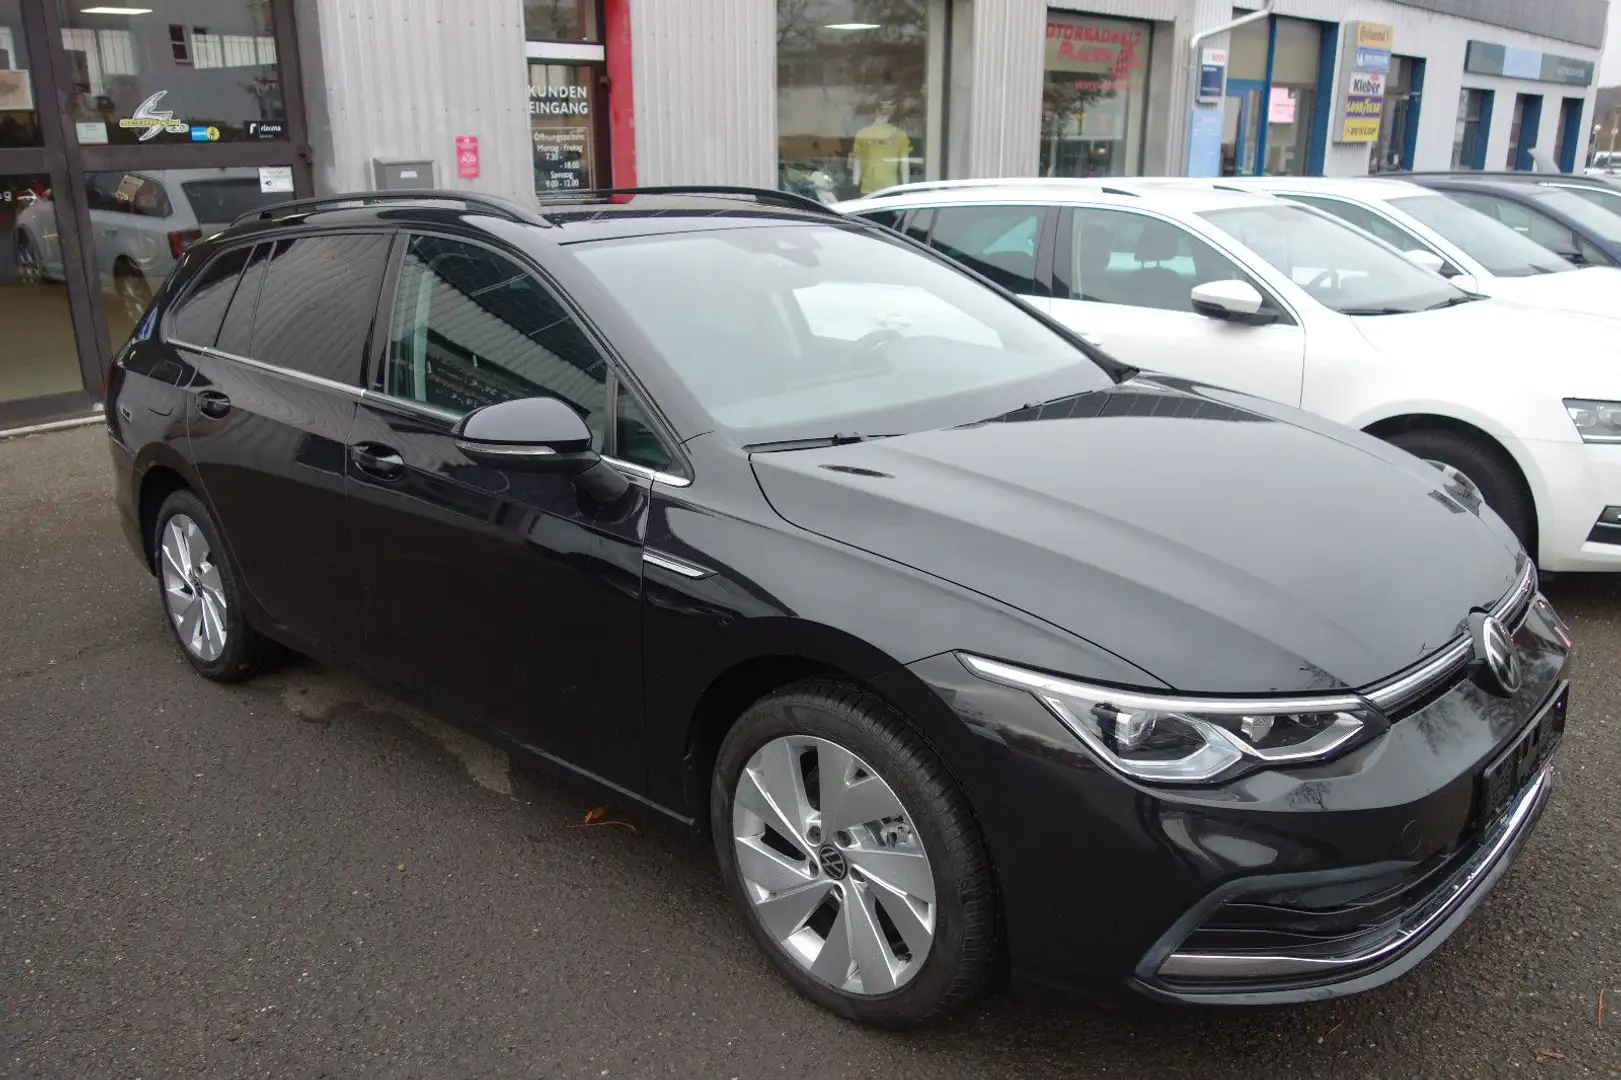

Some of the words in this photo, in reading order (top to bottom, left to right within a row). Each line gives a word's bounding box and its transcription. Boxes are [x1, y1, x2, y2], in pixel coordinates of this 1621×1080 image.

[1046, 23, 1143, 43] OTORRADWELT
[528, 85, 587, 98] KUNDEN
[1353, 78, 1381, 93] Kleber
[529, 102, 589, 114] EINGANG
[537, 144, 560, 153] Montag
[563, 143, 584, 153] Freitag
